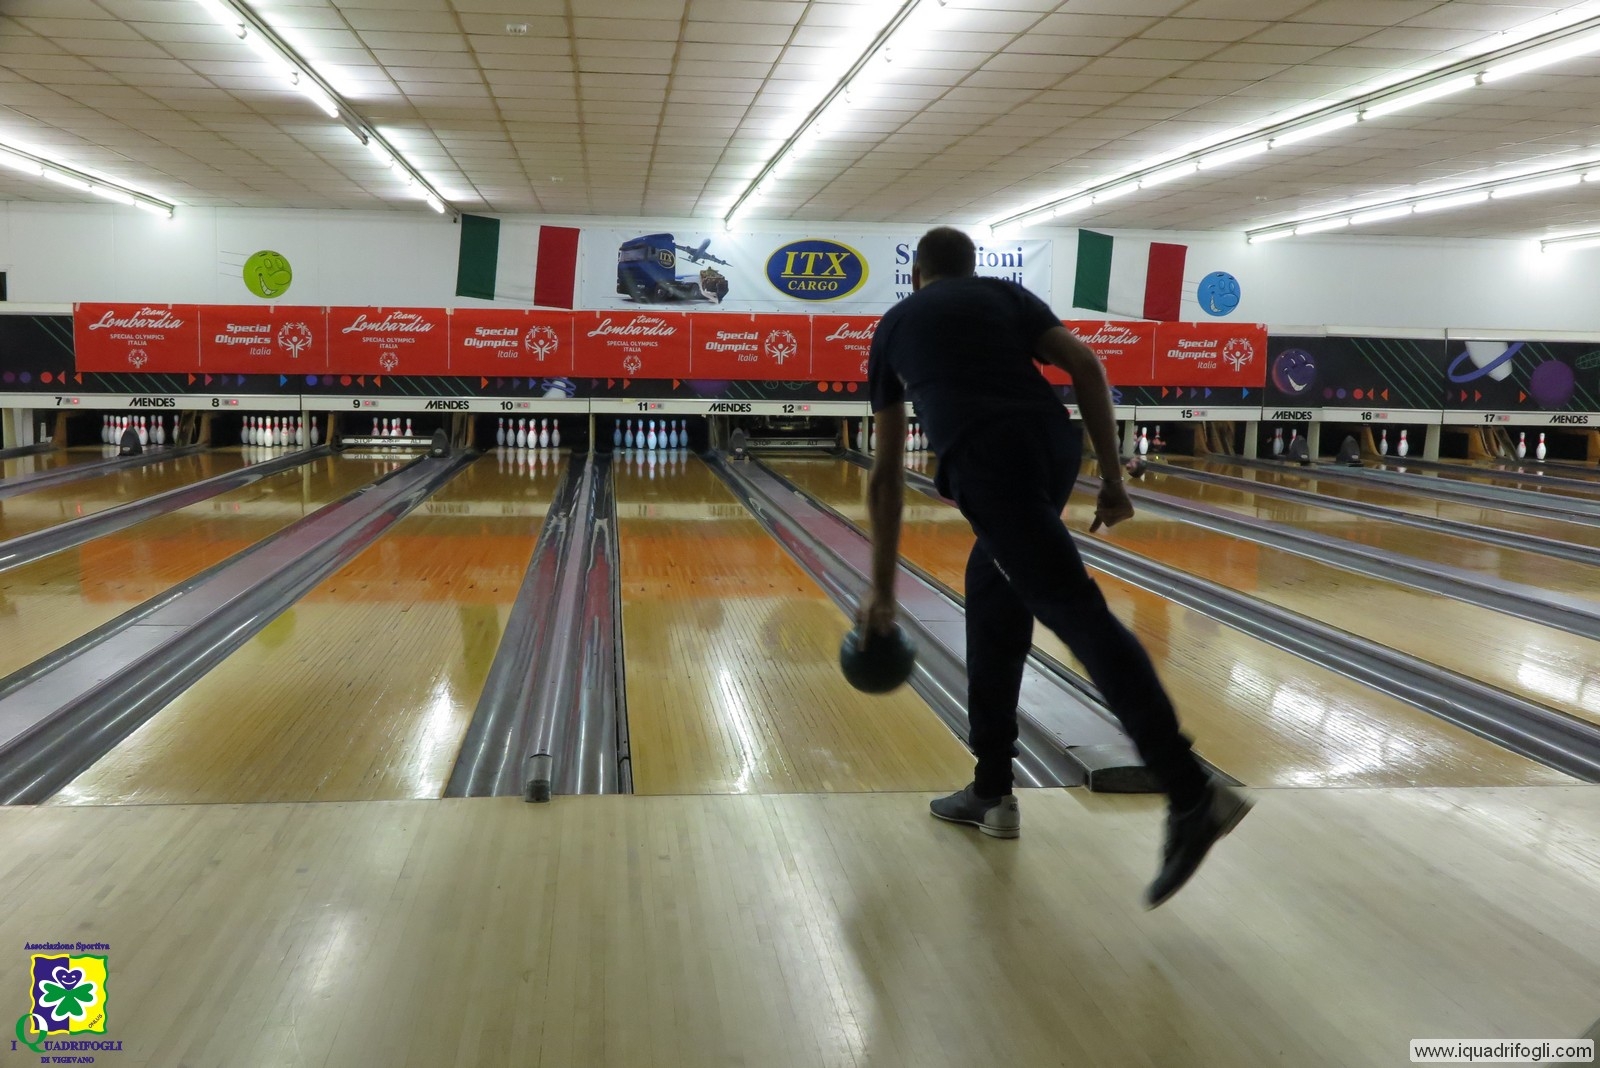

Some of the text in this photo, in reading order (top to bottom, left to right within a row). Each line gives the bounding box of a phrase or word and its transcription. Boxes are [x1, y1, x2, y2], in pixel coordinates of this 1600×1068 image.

[781, 252, 851, 275] ITX
[788, 280, 838, 291] CARGO
[141, 307, 168, 316] team
[393, 310, 418, 320] team
[89, 310, 185, 331] Lombardia
[342, 314, 435, 334] Lombardia
[636, 314, 661, 324] team
[226, 323, 271, 334] Special
[475, 326, 519, 337] Special
[587, 318, 678, 338] Lombardia
[1104, 324, 1127, 332] team
[135, 333, 165, 341] OLYMPICS
[215, 334, 271, 345] Olympics
[716, 330, 759, 341] Special
[464, 337, 519, 349] Olympics
[705, 341, 759, 353] Olympics
[1177, 338, 1218, 349] Special
[250, 346, 272, 356] Italia
[497, 349, 519, 359] Italia
[1167, 349, 1217, 360] Olympics
[738, 353, 759, 363] Italia
[1197, 360, 1217, 370] Italia
[55, 396, 63, 406] 7
[129, 397, 176, 408] MENDES
[211, 399, 220, 408] 8
[352, 399, 361, 409] 9
[425, 400, 470, 411] MENDES
[500, 401, 514, 411] 10
[637, 402, 648, 412] 11
[708, 402, 752, 413] MENDES
[782, 404, 795, 414] 12
[1181, 409, 1193, 419] 15
[1271, 410, 1313, 421] MENDES
[1360, 411, 1372, 421] 16
[1484, 414, 1495, 423] 17
[1549, 415, 1589, 425] MENDES
